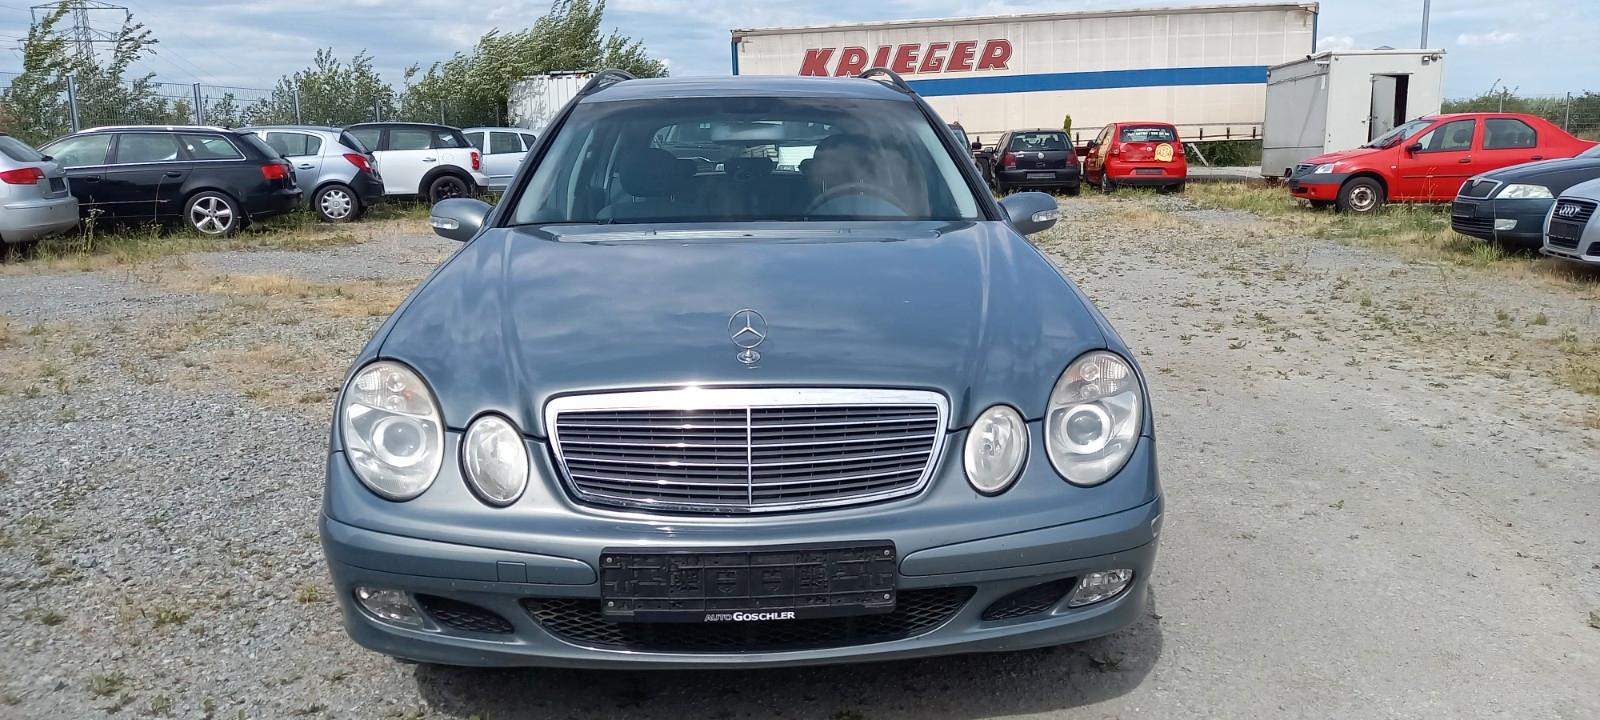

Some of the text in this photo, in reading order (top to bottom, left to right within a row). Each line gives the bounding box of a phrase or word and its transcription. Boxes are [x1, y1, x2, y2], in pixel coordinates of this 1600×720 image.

[799, 39, 1012, 77] KRIEGER
[704, 611, 796, 622] AUTO GOSCHLER
